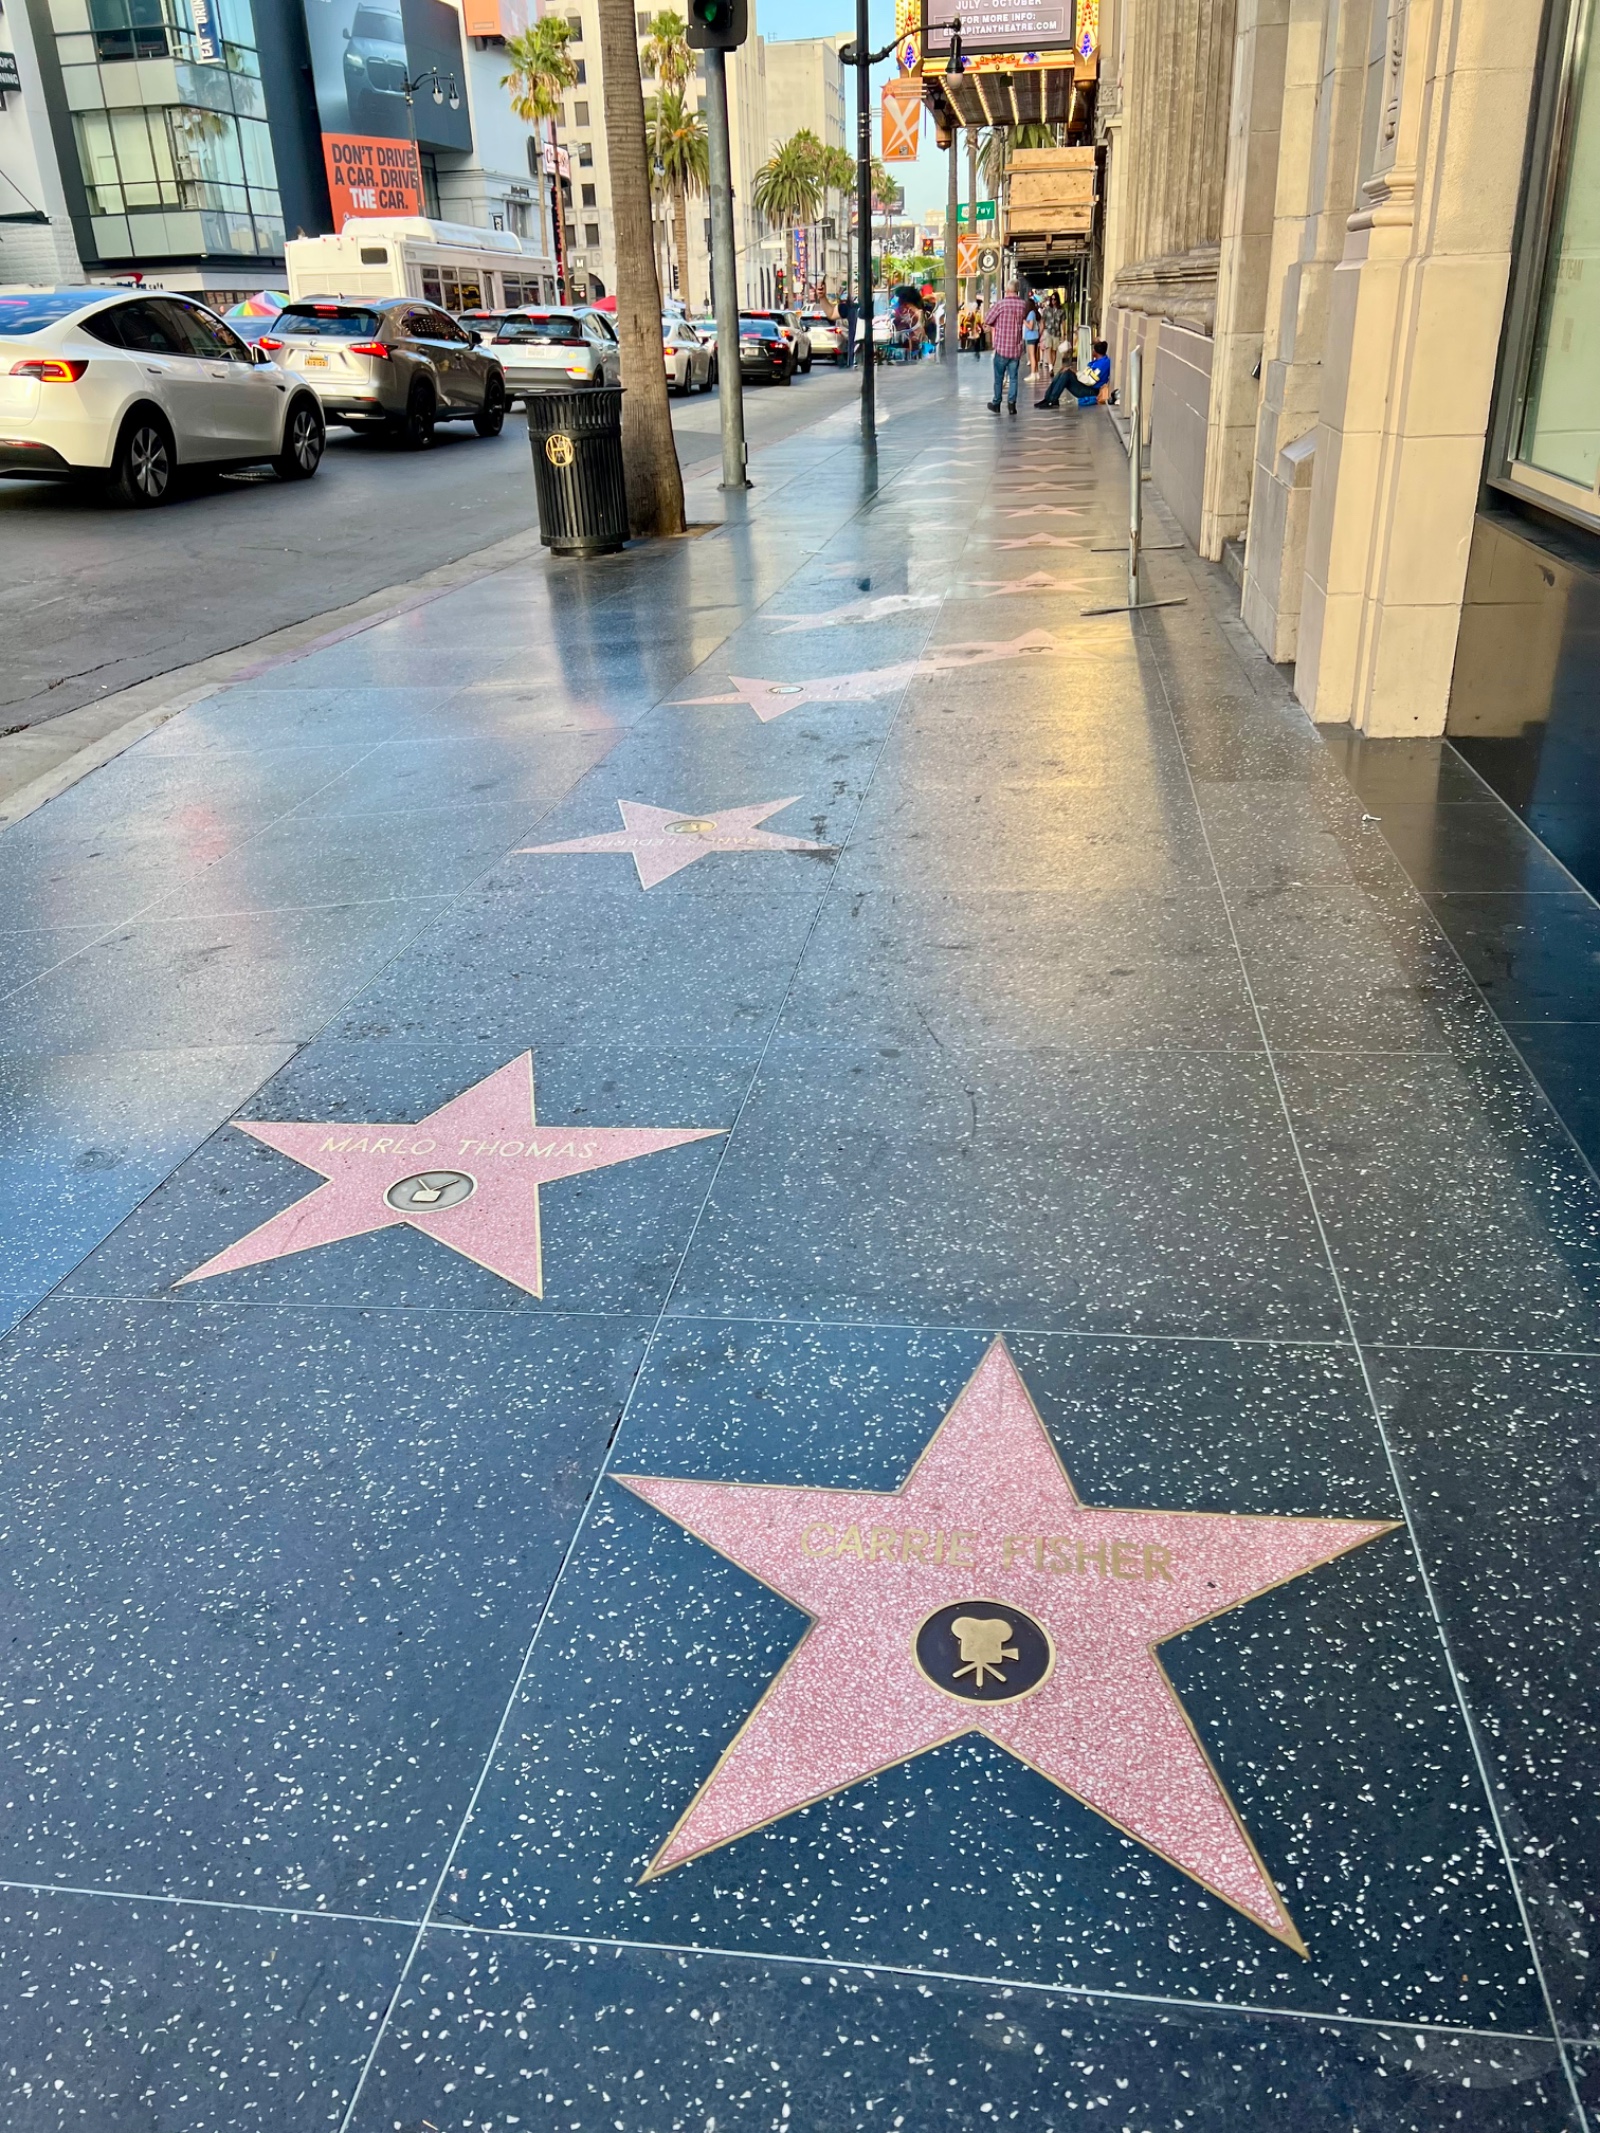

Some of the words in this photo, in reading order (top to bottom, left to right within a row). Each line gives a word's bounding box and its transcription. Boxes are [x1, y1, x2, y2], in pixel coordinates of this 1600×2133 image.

[956, 0, 980, 10] JULY
[943, 21, 1057, 36] ELAPITANTHEATRE.COM
[961, 16, 980, 25] FOR
[982, 13, 1009, 23] MORE
[1012, 12, 1036, 21] INFO:
[199, 37, 214, 57] EAT
[331, 143, 374, 166] DON'T
[376, 146, 417, 169] DRIVE
[335, 165, 345, 185] A
[347, 166, 379, 187] CAR.
[381, 168, 418, 190] DRIVE
[349, 187, 377, 209] THE
[378, 189, 409, 210] CAR.
[318, 1136, 437, 1156] MARLO
[450, 1139, 599, 1160] THOMAS
[800, 1521, 977, 1569] CARRIE
[1002, 1534, 1174, 1582] FISHER
